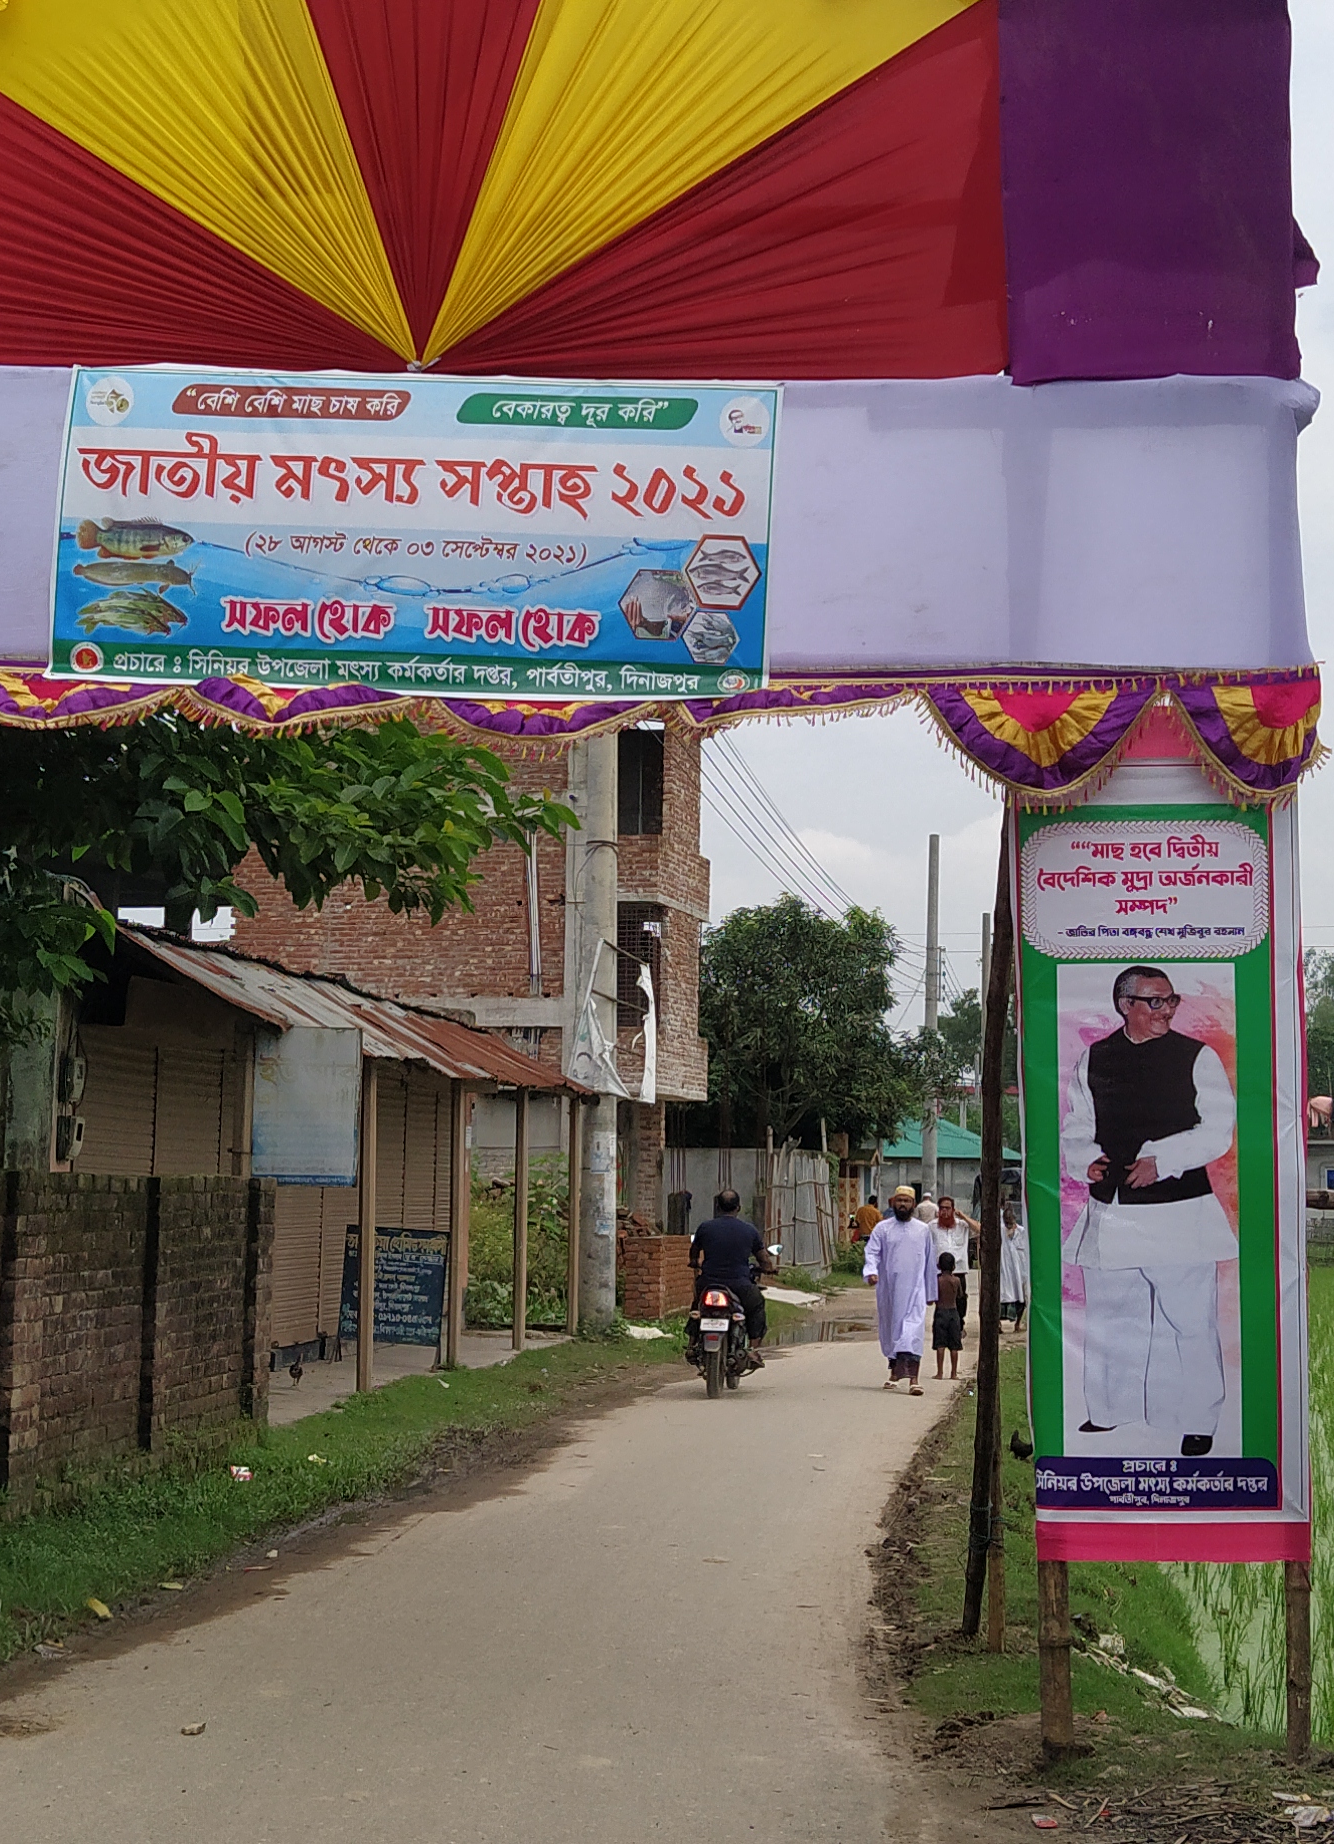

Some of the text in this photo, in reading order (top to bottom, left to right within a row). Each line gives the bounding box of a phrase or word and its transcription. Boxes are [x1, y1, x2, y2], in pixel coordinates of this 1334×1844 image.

[186, 387, 403, 417] “বেশি বেশি মাছ চাষ করি
[492, 397, 669, 428] বেকারত্ব দূর করি”
[77, 432, 746, 522] জাতীয় মৎস্য সপ্তাহ ২০২১
[244, 530, 589, 568] (২৮ আগস্ট থেকে ০৩ সেপ্টেম্বর ২০২১)
[224, 598, 599, 648] সফল হোক সফল হোক
[113, 652, 168, 674] প্রচারে
[188, 648, 252, 676] সিনিয়র
[256, 651, 331, 680] উপজেলা
[335, 659, 382, 682] মৎস্য
[386, 655, 468, 685] কর্মকর্তার
[472, 664, 518, 690] দপ্তর,
[526, 662, 613, 692] পার্বতীপুর,
[619, 664, 701, 693] দিনাজপুর
[1129, 841, 1161, 862] হবে
[1167, 834, 1219, 860] দ্বিতীয়
[1037, 862, 1254, 892] বৈদেশিক মুদ্রা অর্জনকারী
[1065, 924, 1096, 938] জাতির
[1098, 925, 1120, 938] পিতা
[1122, 927, 1154, 940] বঙ্গবন্ধু
[1155, 927, 1175, 939] শেখ
[1122, 1460, 1166, 1474] প্রচারে
[1080, 1473, 1136, 1495] উপজেলা
[1138, 1476, 1170, 1494] মৎস্য
[1172, 1470, 1235, 1493] কর্মকর্তার
[1237, 1476, 1268, 1493] দপ্তর
